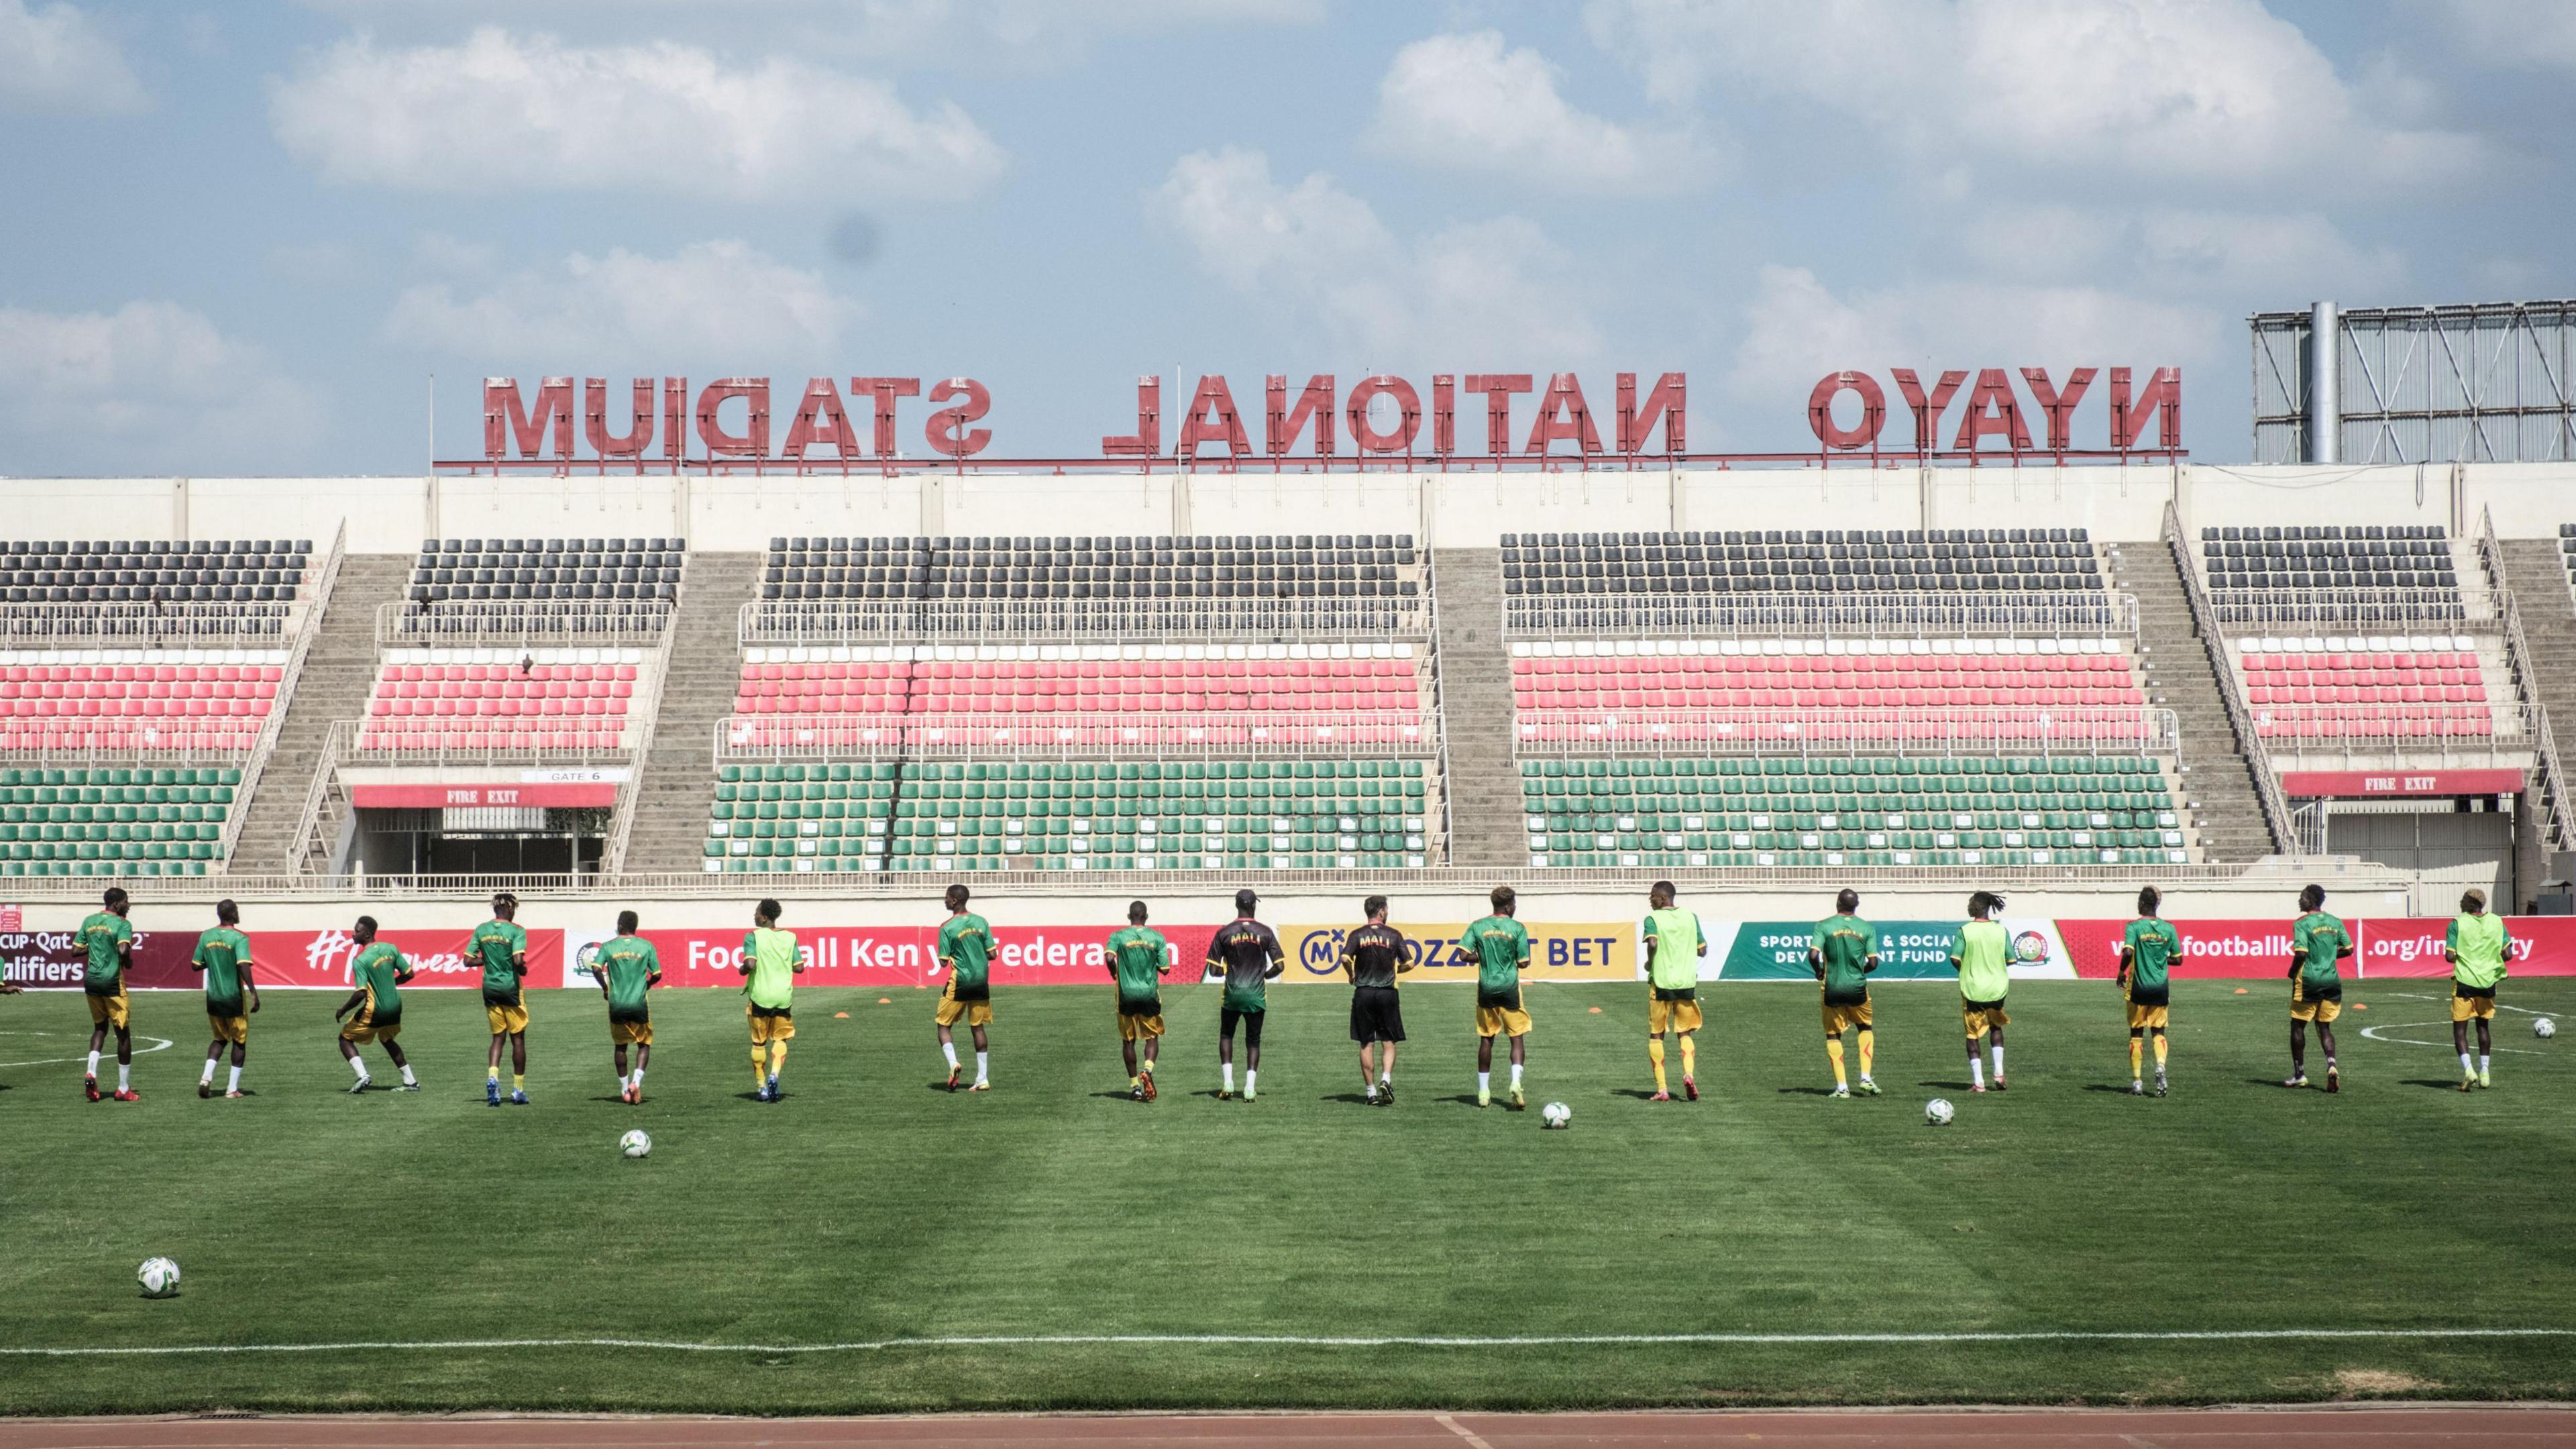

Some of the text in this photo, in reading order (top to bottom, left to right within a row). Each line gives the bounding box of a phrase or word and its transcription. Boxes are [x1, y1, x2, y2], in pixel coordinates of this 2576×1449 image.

[551, 773, 584, 781] GATE
[2365, 777, 2436, 791] FIRE EXIT
[447, 790, 519, 804] FIRE EXIT
[36, 932, 72, 955] Qat
[1231, 932, 1260, 945] MALI
[1360, 934, 1389, 949] MALI
[1760, 935, 1813, 948] SPORT
[1882, 934, 1894, 947] &
[1548, 938, 1617, 966] BET
[2367, 935, 2534, 961] .org/inty
[689, 936, 1179, 975] Fooall Keny ederan
[1901, 951, 1947, 963] FUND
[3, 955, 84, 981] alifiers
